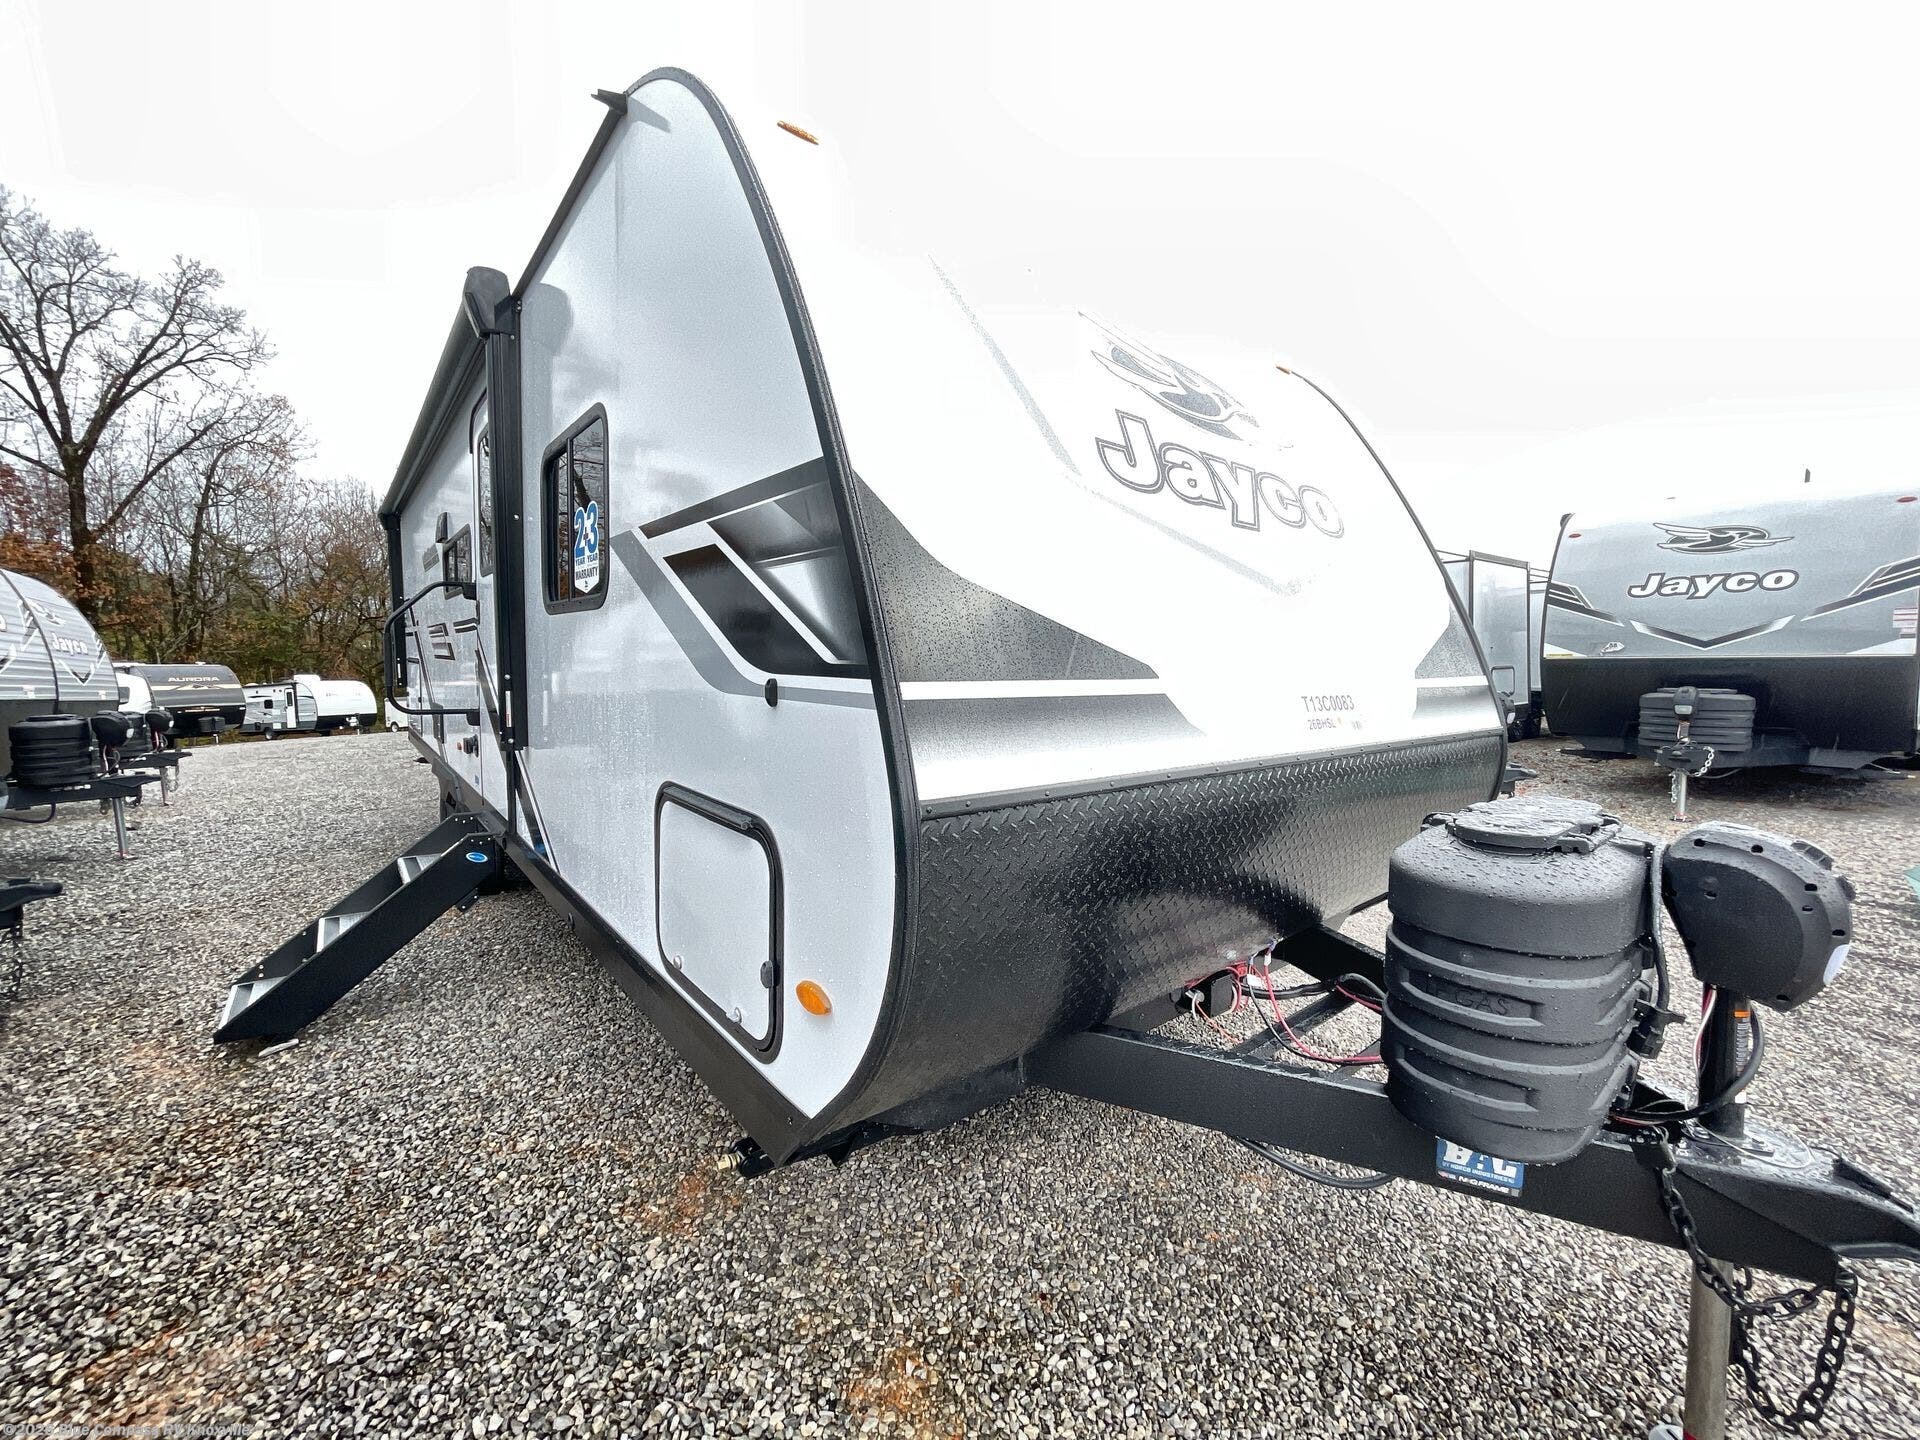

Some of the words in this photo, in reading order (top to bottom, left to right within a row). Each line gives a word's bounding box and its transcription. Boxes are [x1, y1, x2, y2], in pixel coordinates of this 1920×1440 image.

[1094, 408, 1345, 539] Jayco
[575, 557, 586, 567] YEAR
[587, 553, 598, 563] YEAR
[575, 566, 598, 580] WARRANTY
[1627, 569, 1799, 600] Jayco
[52, 633, 89, 656] Jayco
[1301, 695, 1355, 712] T13C0083
[1455, 989, 1508, 1016] GAS
